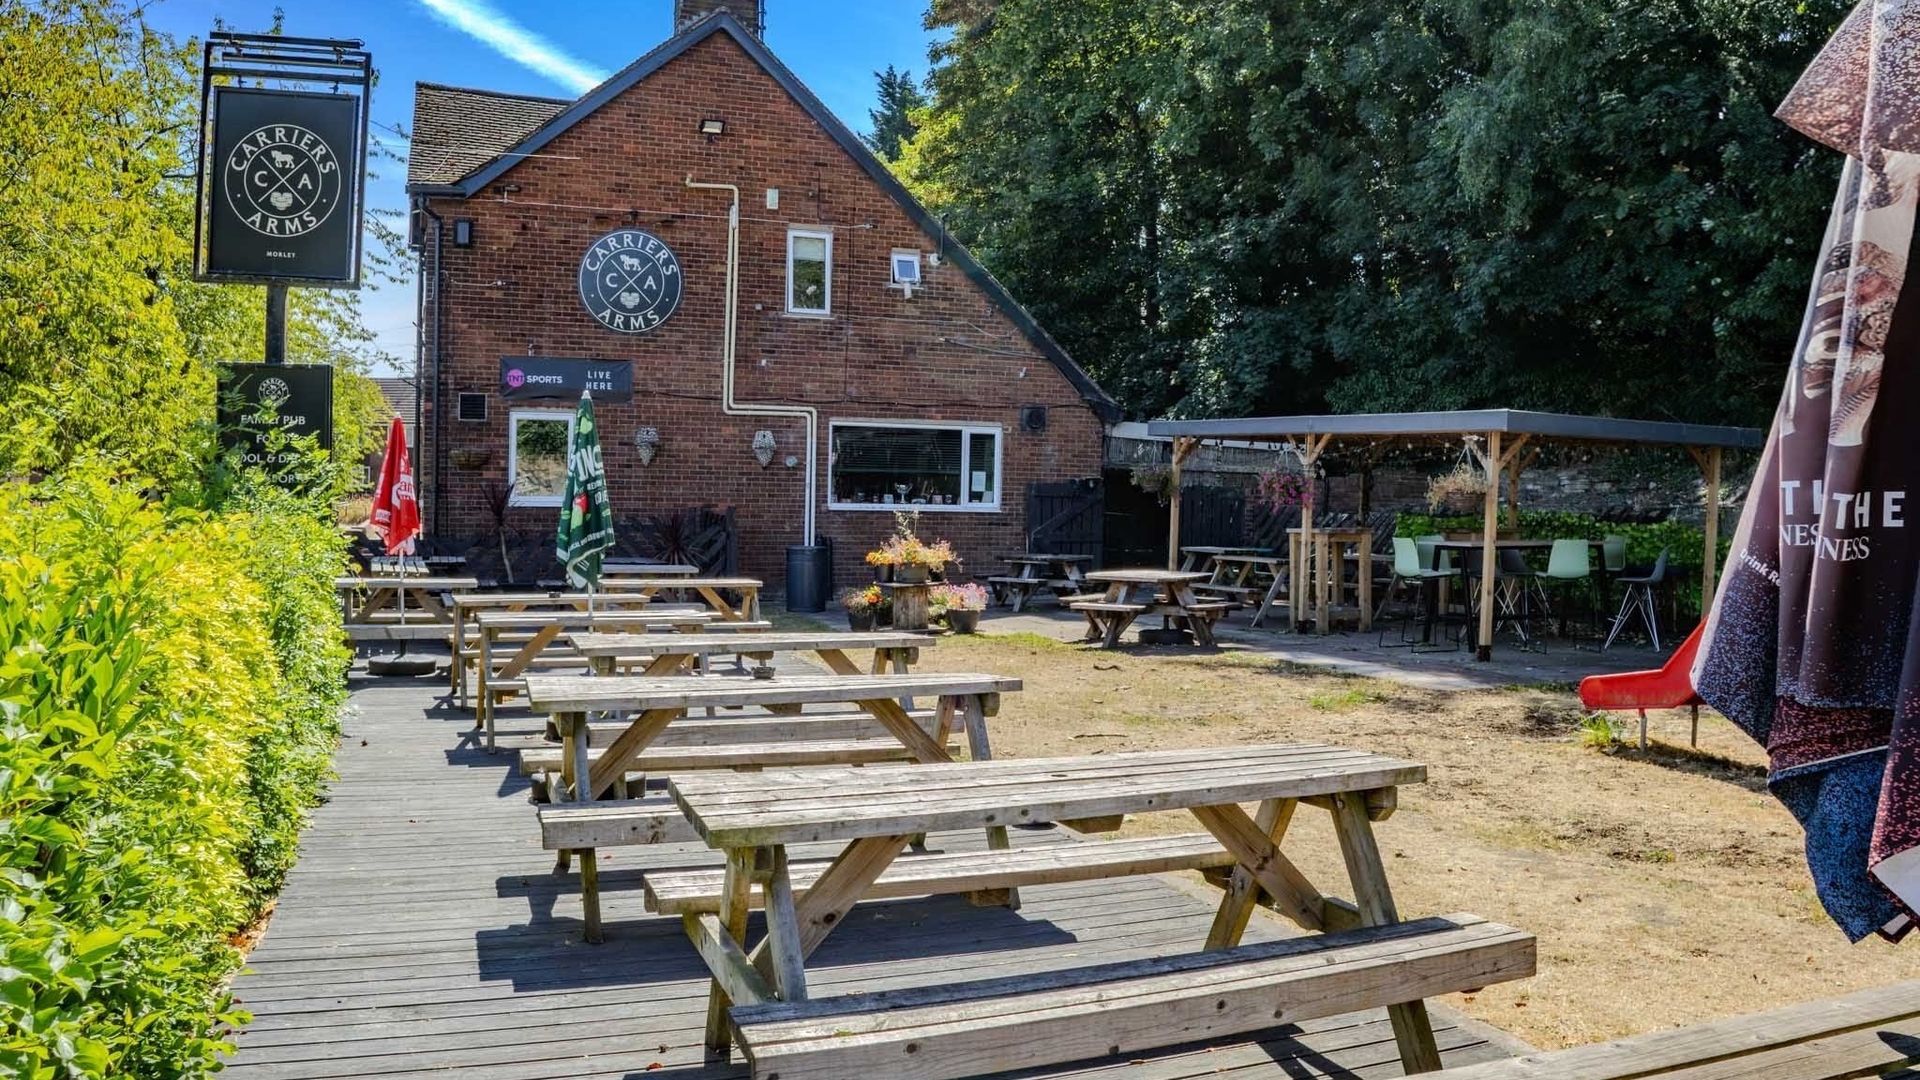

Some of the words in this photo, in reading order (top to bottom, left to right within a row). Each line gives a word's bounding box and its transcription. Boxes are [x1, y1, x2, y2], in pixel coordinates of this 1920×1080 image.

[231, 127, 336, 174] CARRIERS
[254, 170, 268, 187] C
[297, 173, 313, 190] A
[247, 211, 317, 235] ARMS
[586, 233, 677, 275] CARRIERS
[605, 272, 618, 288] C
[643, 275, 657, 290] A
[598, 308, 660, 330] ARMS
[526, 375, 563, 384] SPORTS
[587, 370, 611, 380] LIVE
[586, 381, 613, 390] HERE
[283, 415, 306, 425] PUB
[241, 453, 263, 464] OOL
[1832, 491, 1906, 530] THE
[1740, 548, 1770, 577] Drink
